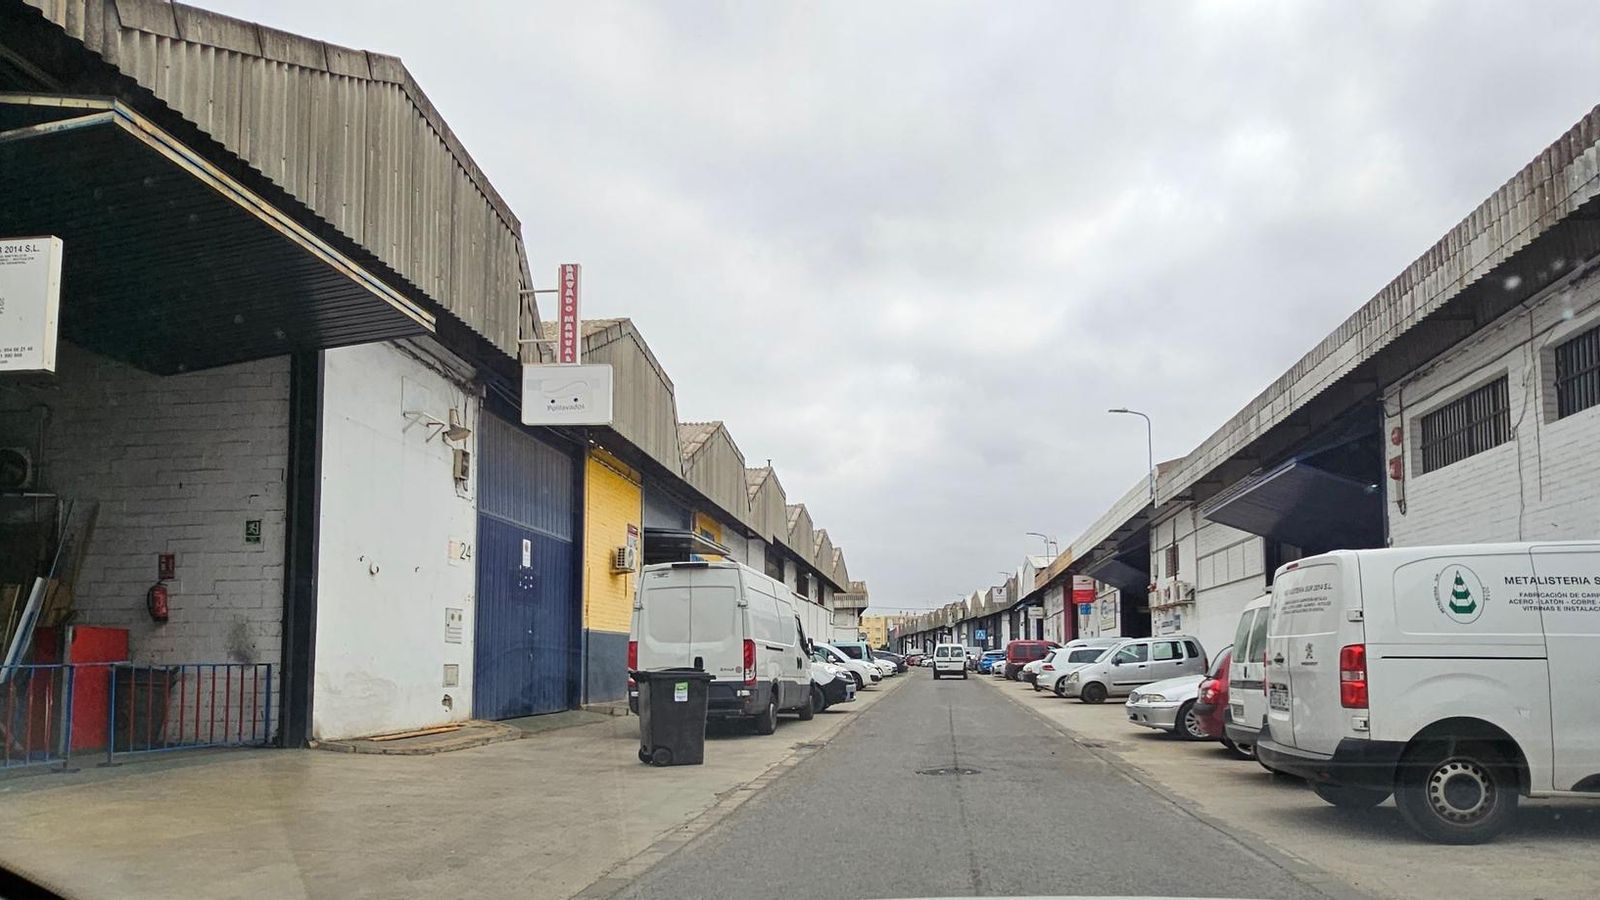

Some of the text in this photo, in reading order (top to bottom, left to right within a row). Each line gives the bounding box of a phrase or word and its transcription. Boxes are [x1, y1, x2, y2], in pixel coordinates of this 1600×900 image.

[4, 245, 23, 253] 2014
[25, 244, 40, 253] S.L.
[564, 315, 574, 362] MANUAL
[460, 542, 471, 560] 24
[1504, 576, 1591, 585] METALISTERIA
